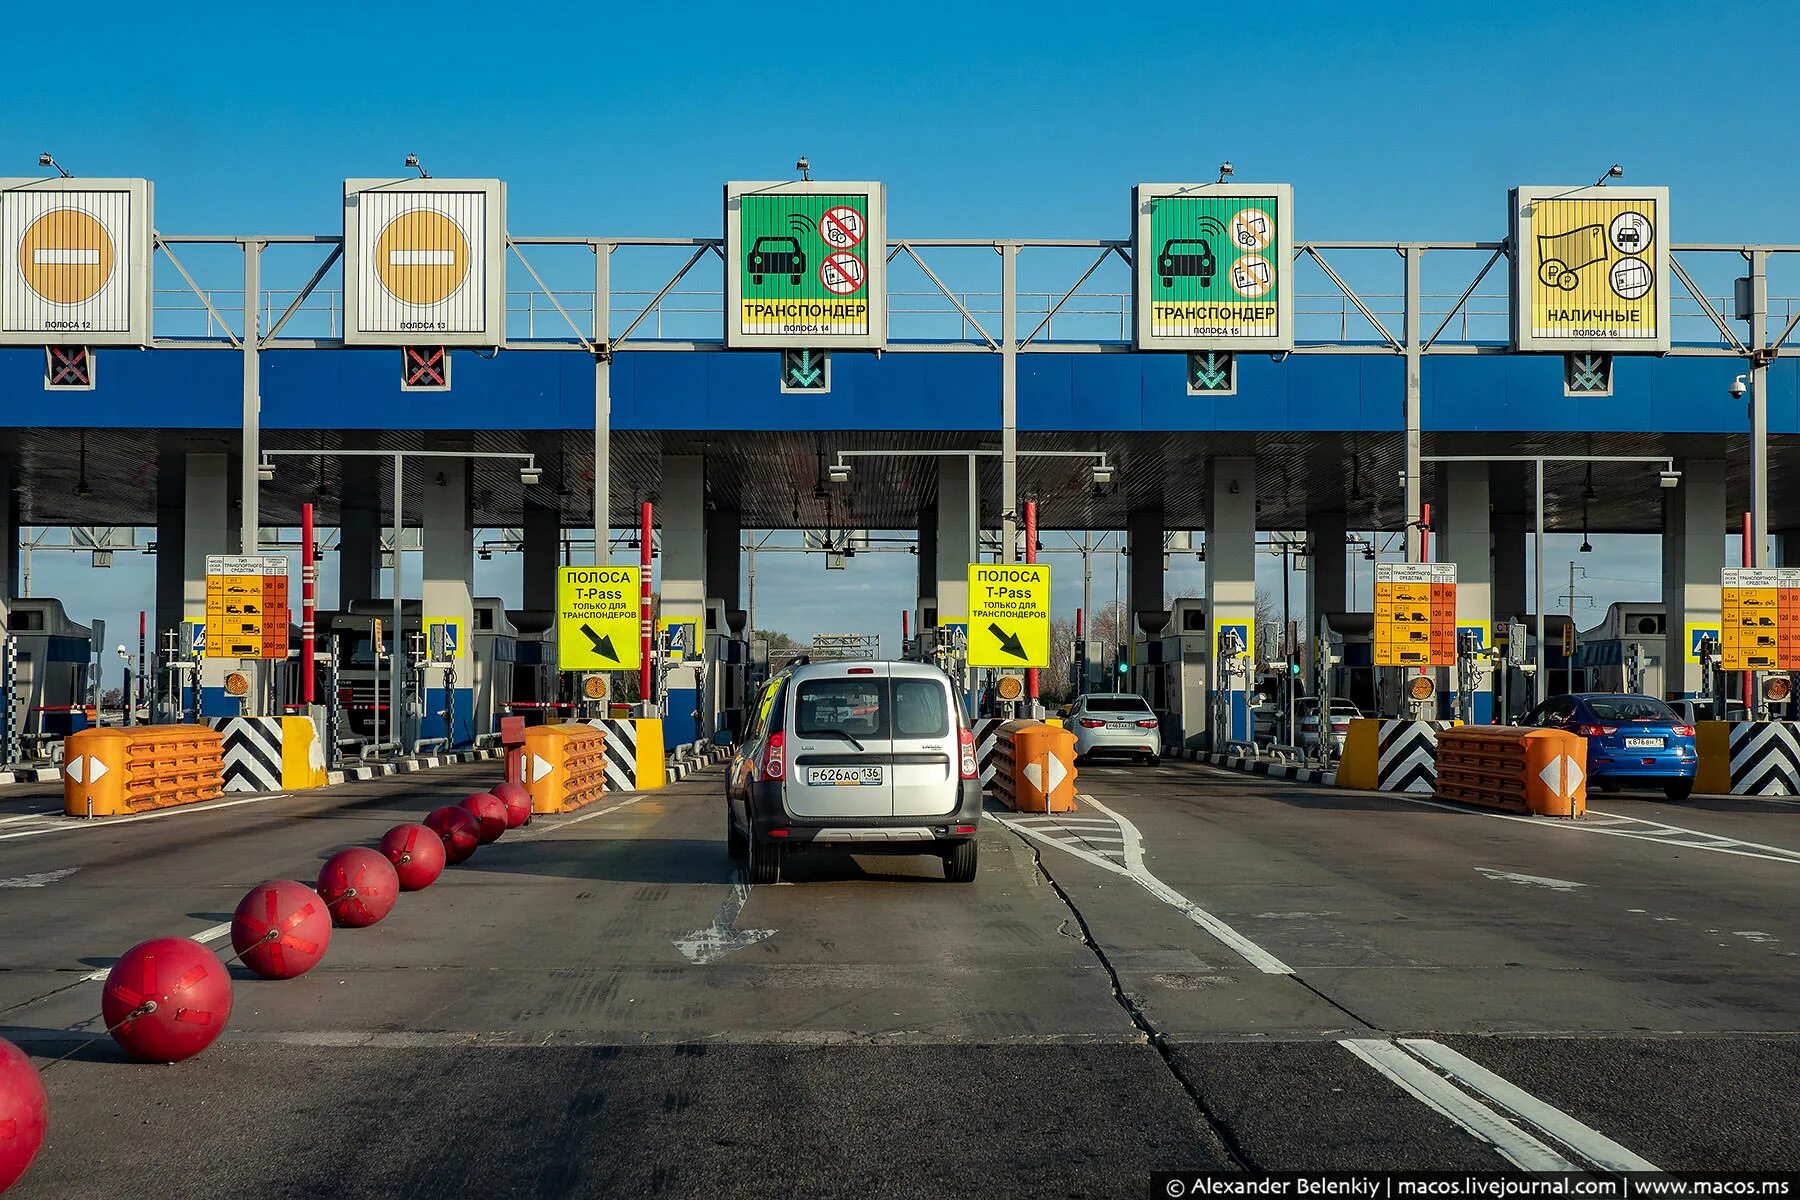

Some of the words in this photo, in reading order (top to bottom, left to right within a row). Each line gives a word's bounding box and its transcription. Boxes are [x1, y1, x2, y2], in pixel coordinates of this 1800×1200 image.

[745, 305, 866, 319] ТРАНСПОНДЕР
[1155, 308, 1275, 321] ТРАНСПОНДЕР
[1548, 310, 1639, 321] НАЛИЧНЫЕ
[568, 572, 630, 583] ПОЛОСА
[978, 571, 1040, 582] ПОЛОСА
[576, 588, 622, 599] T-Pass
[986, 587, 1032, 598] T-Pass
[812, 769, 858, 780] Р626АО
[861, 769, 878, 777] 136
